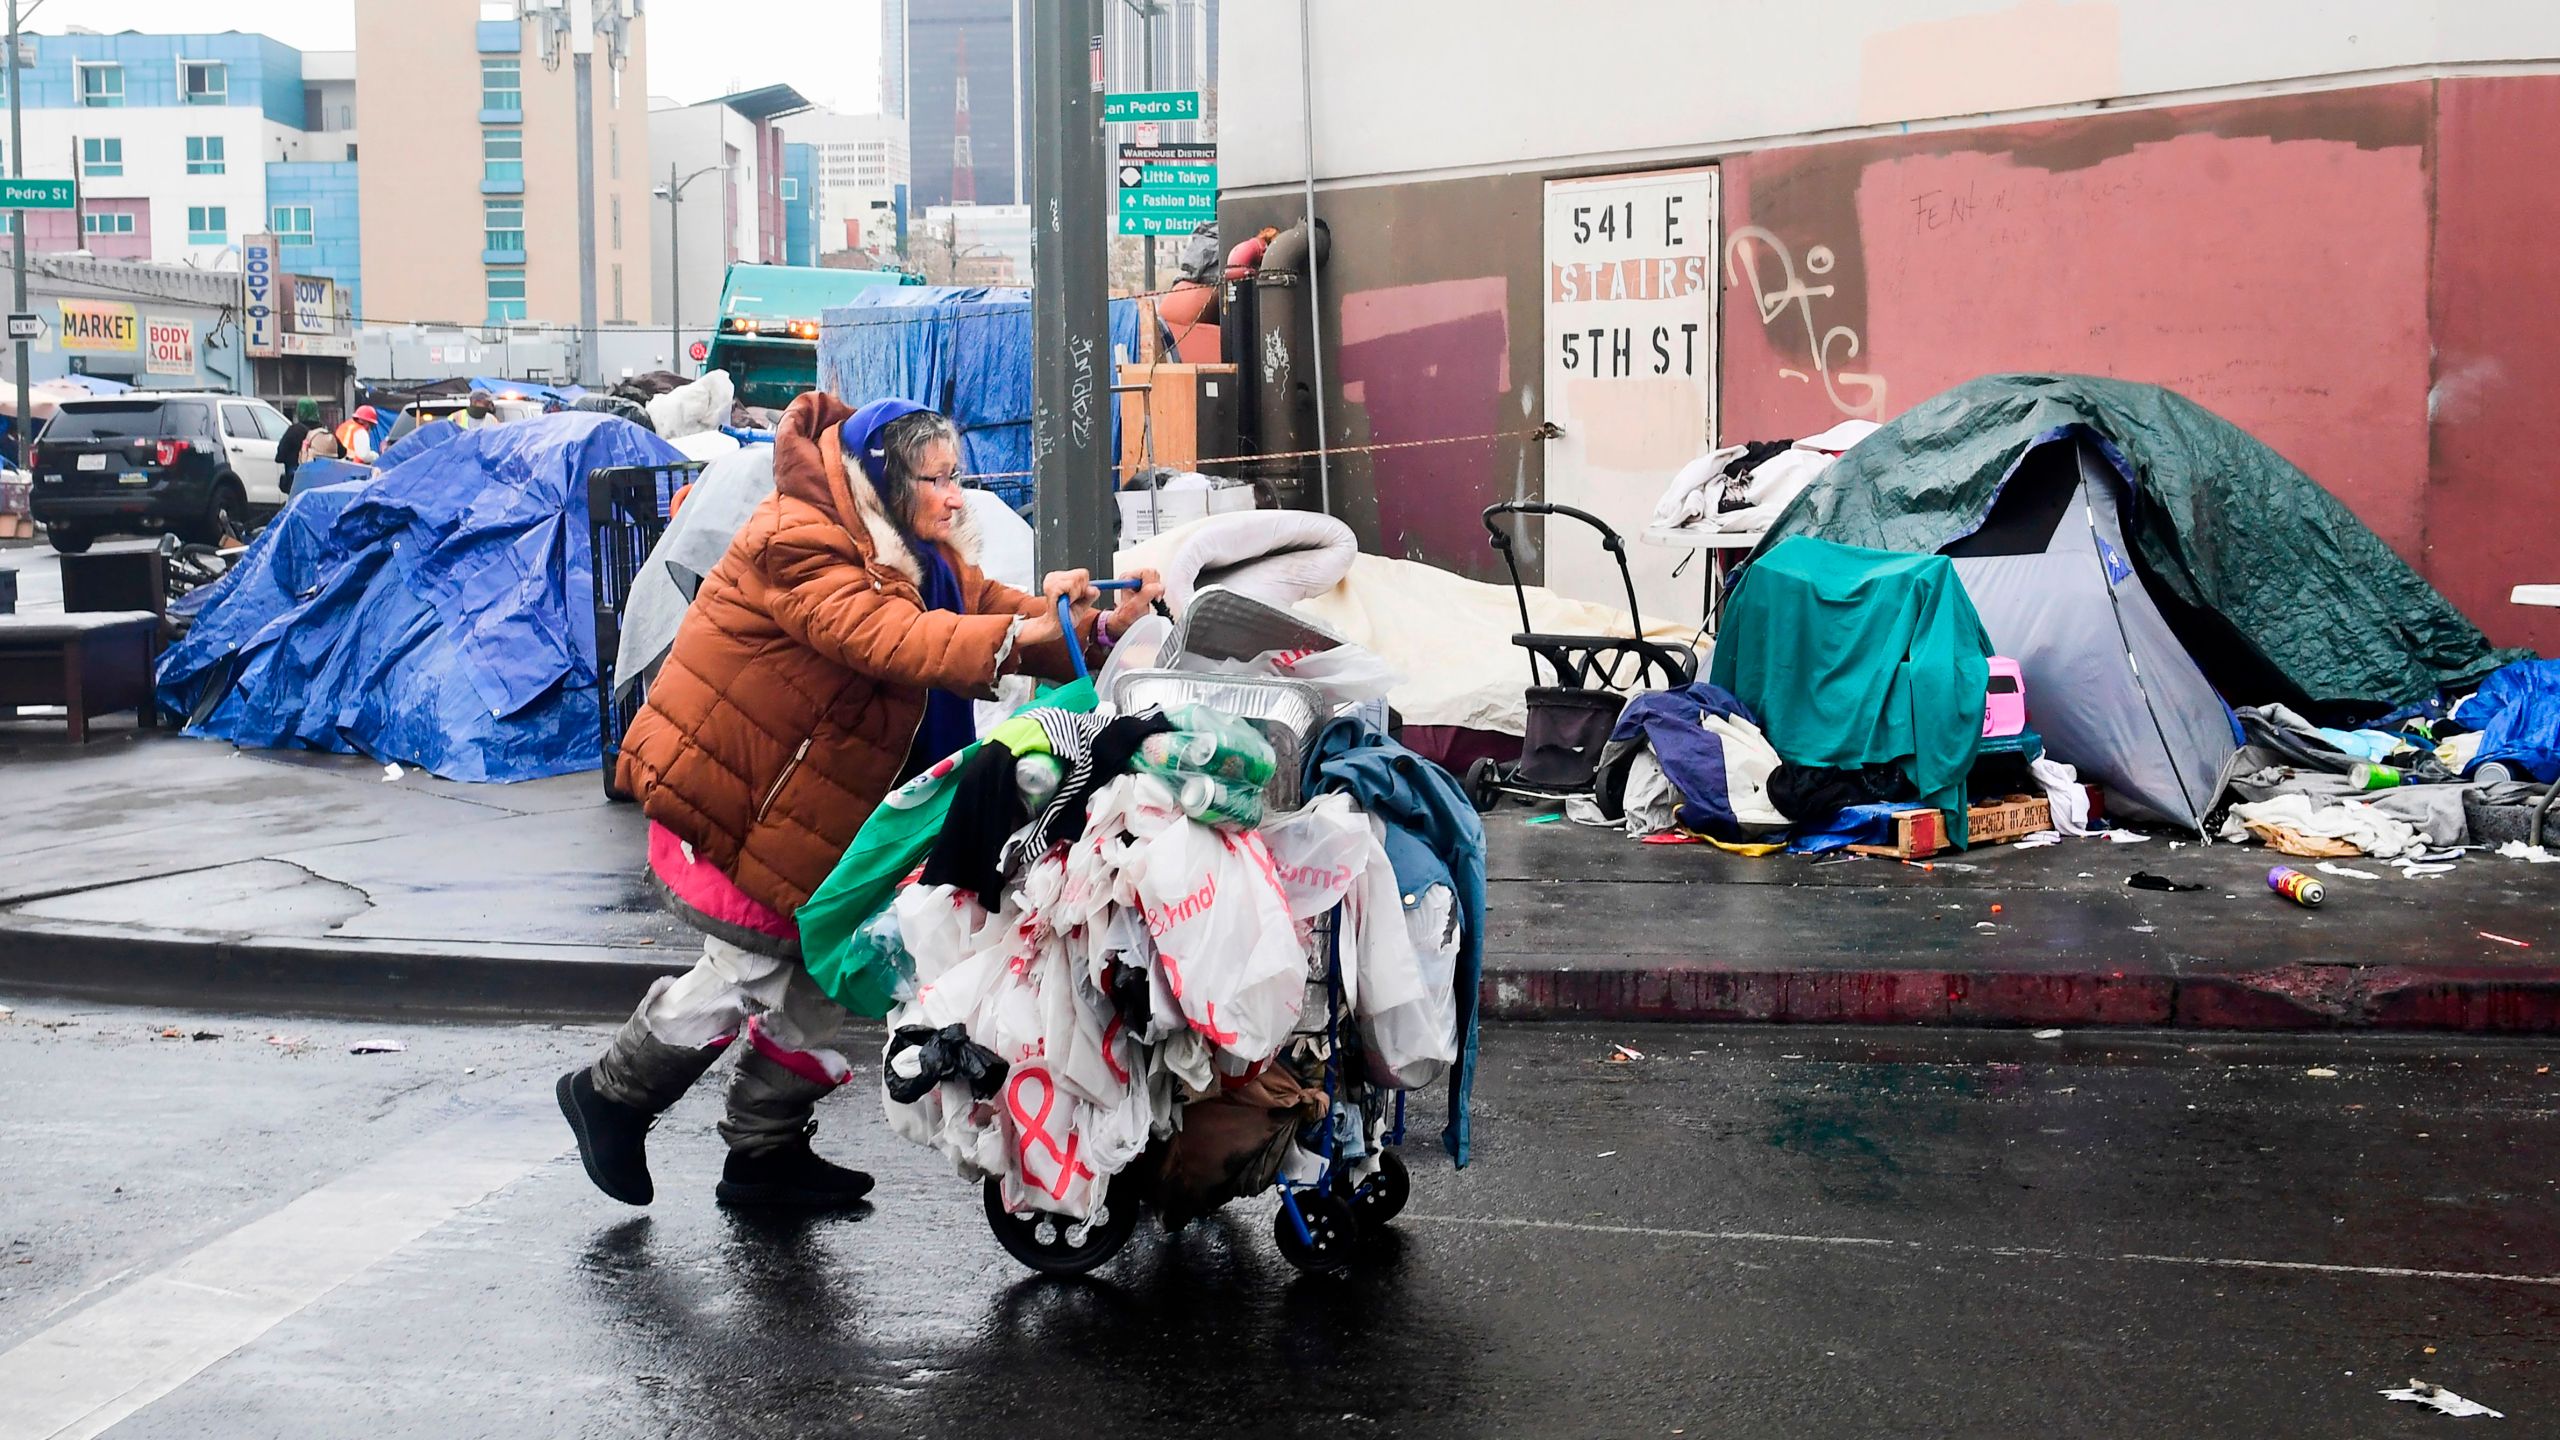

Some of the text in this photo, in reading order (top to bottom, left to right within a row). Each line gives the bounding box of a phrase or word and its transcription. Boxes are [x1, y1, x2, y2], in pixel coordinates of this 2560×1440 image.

[1130, 101, 1171, 113] Pedro
[1176, 100, 1193, 112] St
[1123, 149, 1216, 158] WAREHOUSE DISTRICT
[1143, 171, 1210, 186] Little Tokyo
[6, 187, 67, 200] Pedro St
[1143, 194, 1211, 207] Fashion Dist
[1143, 218, 1209, 232] Toy Distri
[1574, 196, 1683, 247] 541 E
[247, 247, 269, 302] BODY
[1560, 256, 1704, 303] STAIRS
[64, 312, 134, 340] MARKET
[247, 305, 270, 346] OIL
[150, 326, 191, 344] BODY
[159, 344, 182, 361] OIL
[1562, 323, 1698, 378] 5TH ST
